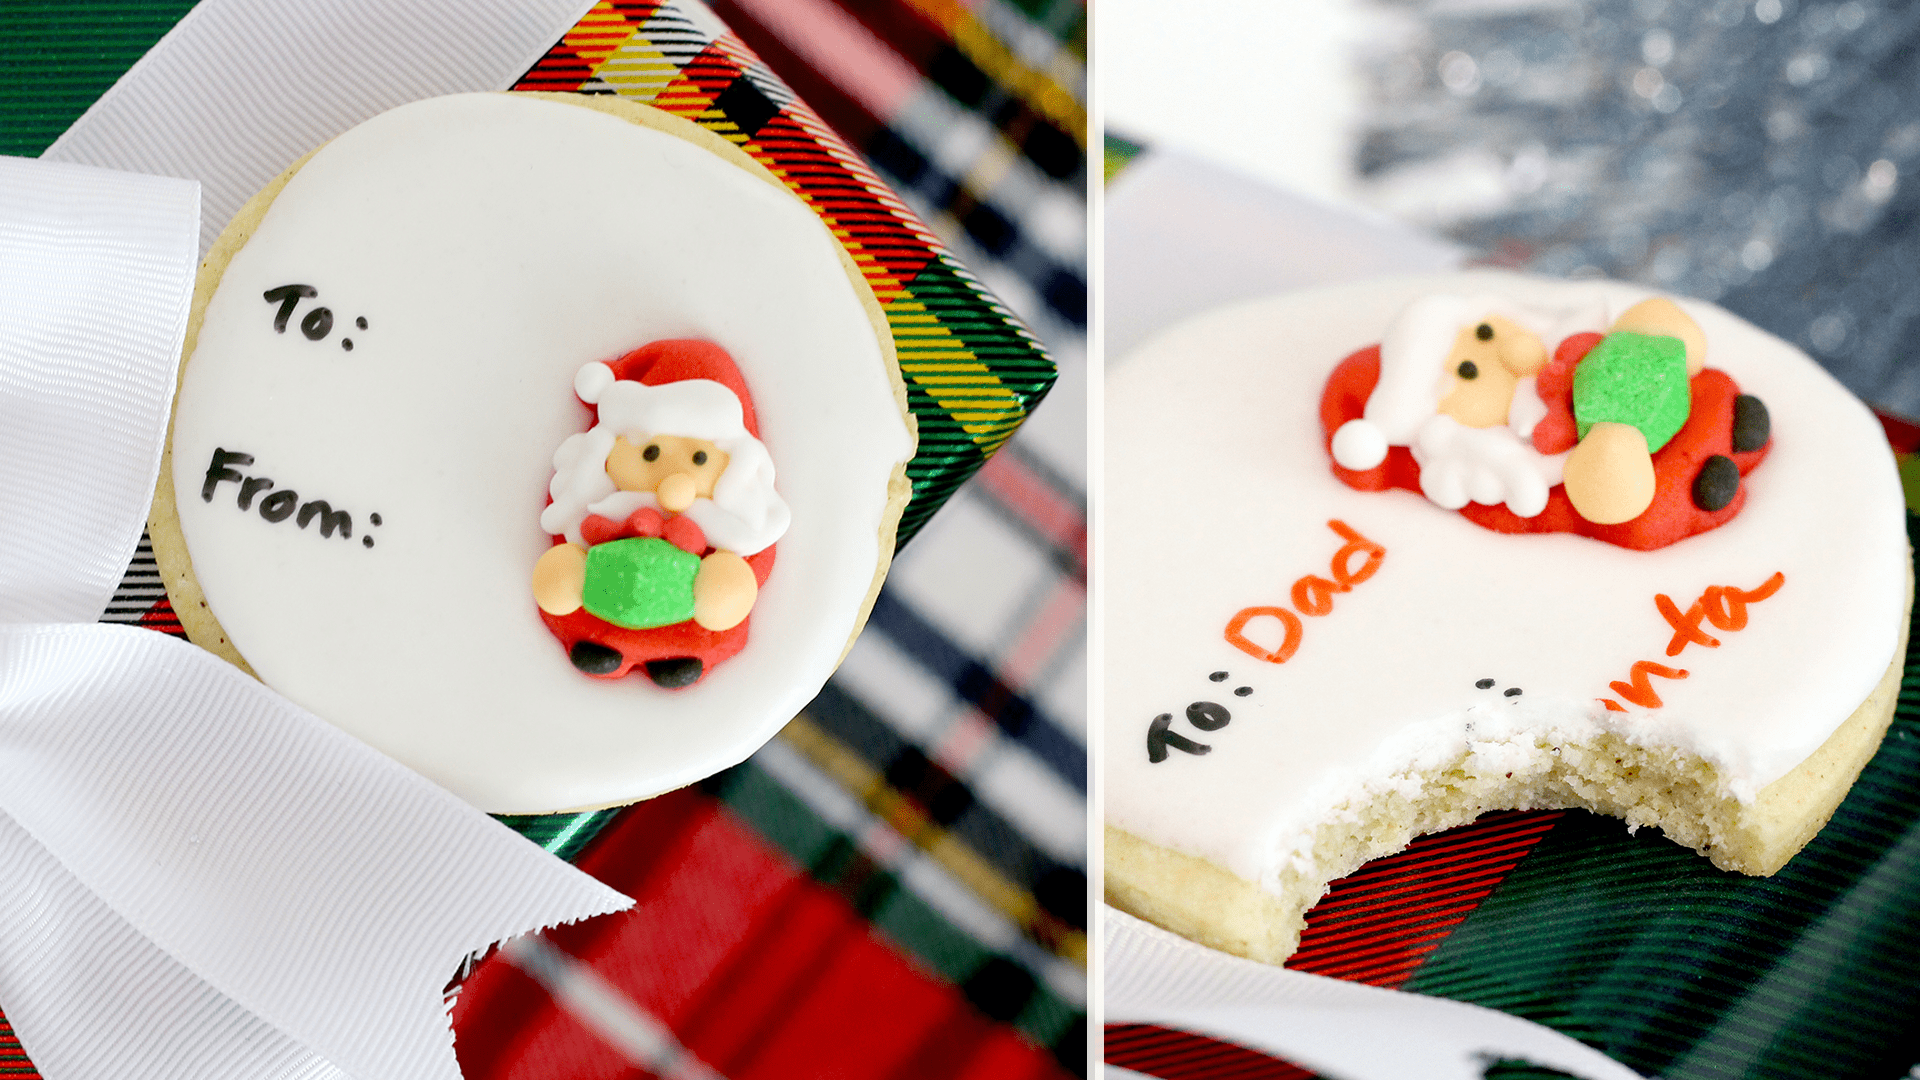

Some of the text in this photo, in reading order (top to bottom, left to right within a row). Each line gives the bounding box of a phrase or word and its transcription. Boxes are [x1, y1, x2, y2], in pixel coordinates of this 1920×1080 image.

[262, 283, 369, 352] To:
[201, 446, 383, 549] From:
[1146, 518, 1387, 764] To: Dad
[1595, 570, 1786, 714] nta
